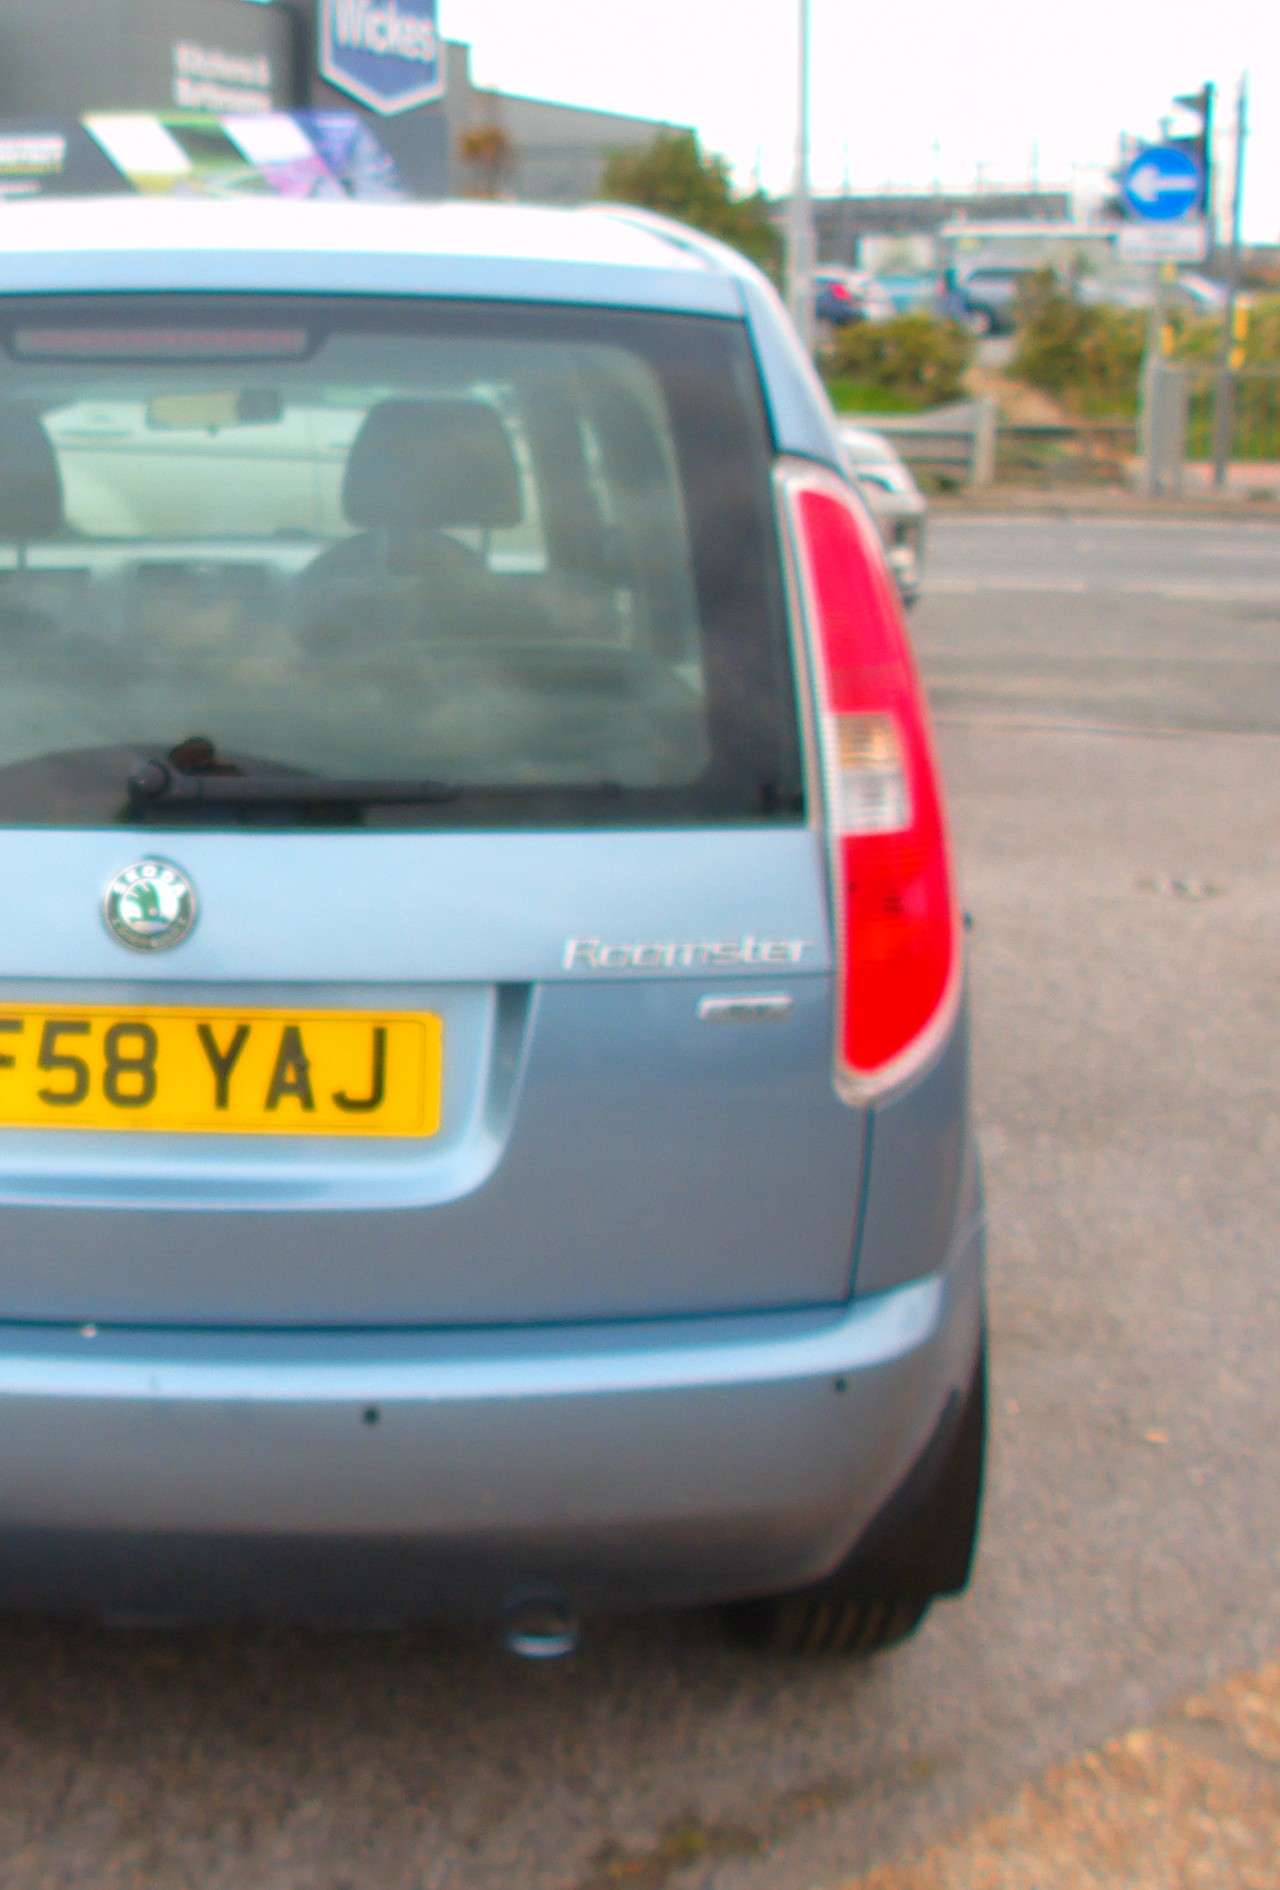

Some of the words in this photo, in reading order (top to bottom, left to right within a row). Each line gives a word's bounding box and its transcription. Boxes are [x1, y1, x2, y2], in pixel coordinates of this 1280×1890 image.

[334, 0, 436, 62] Wickes
[563, 936, 811, 971] Roomster
[196, 1022, 389, 1114] YAJ
